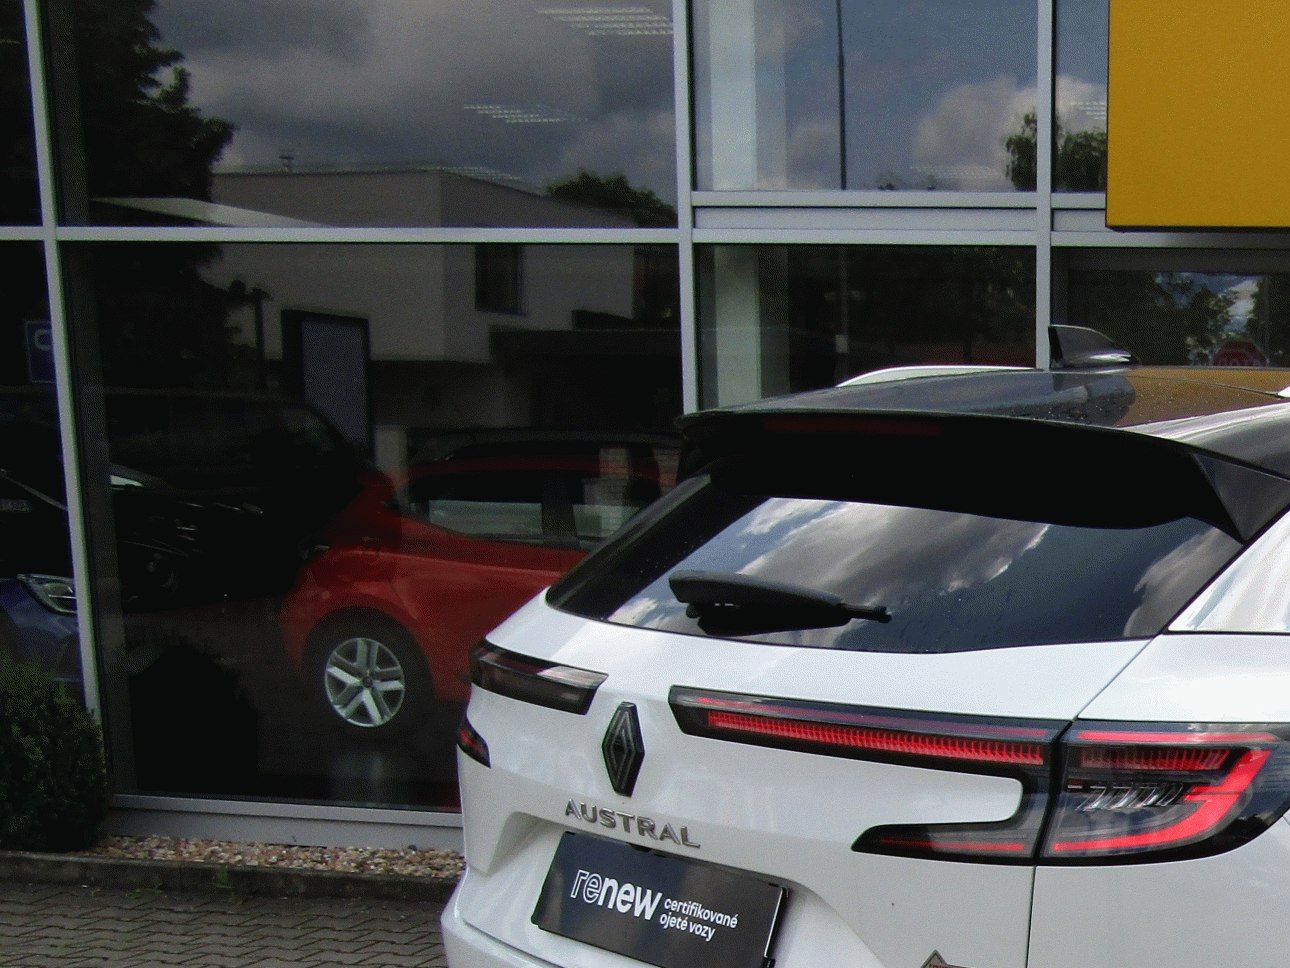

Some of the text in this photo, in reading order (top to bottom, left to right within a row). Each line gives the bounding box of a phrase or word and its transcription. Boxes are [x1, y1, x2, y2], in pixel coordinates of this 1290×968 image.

[565, 798, 701, 849] AUSTRAL
[570, 869, 663, 921] renew
[664, 897, 738, 929] certifikované
[659, 912, 716, 942] ojeté vozy
